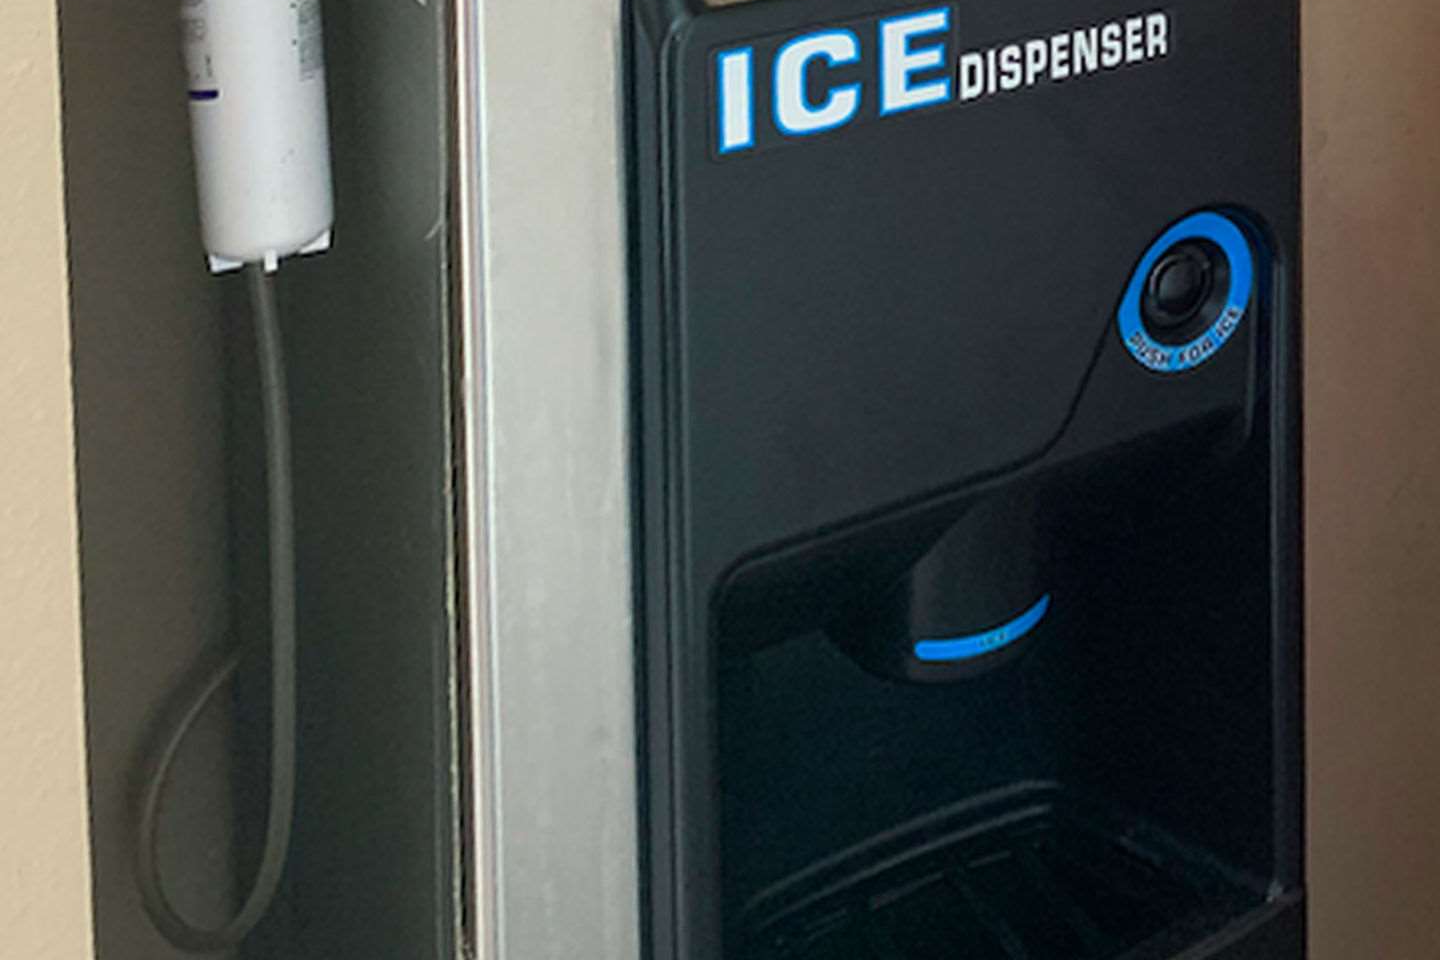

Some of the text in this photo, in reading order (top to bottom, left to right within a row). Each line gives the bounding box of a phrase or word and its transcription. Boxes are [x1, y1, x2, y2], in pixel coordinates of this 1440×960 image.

[717, 5, 1168, 155] ICE DISPENSER
[1129, 305, 1244, 366] PUSH FOR ICE
